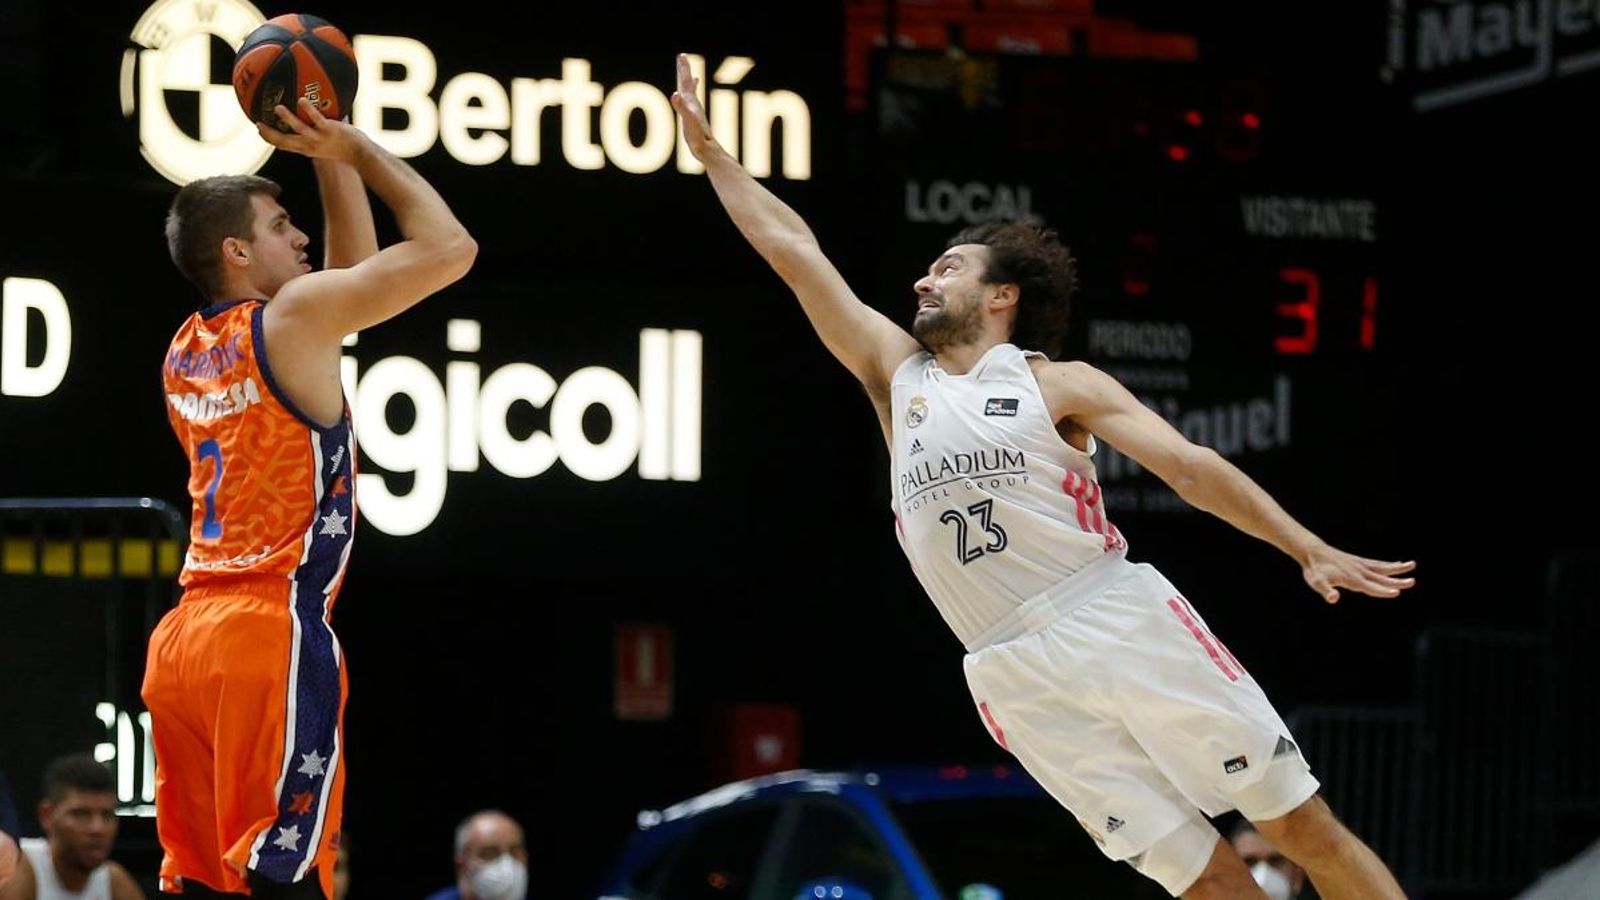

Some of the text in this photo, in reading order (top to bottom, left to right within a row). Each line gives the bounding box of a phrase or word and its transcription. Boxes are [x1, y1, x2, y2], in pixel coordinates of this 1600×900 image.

[1415, 0, 1600, 84] Maye
[353, 34, 811, 181] Bertolín
[904, 179, 1044, 224] LOCAL
[1239, 193, 1378, 242] VISITANTE
[1, 276, 72, 397] D
[901, 448, 1025, 496] PALLADIUM
[940, 498, 1008, 566] 23
